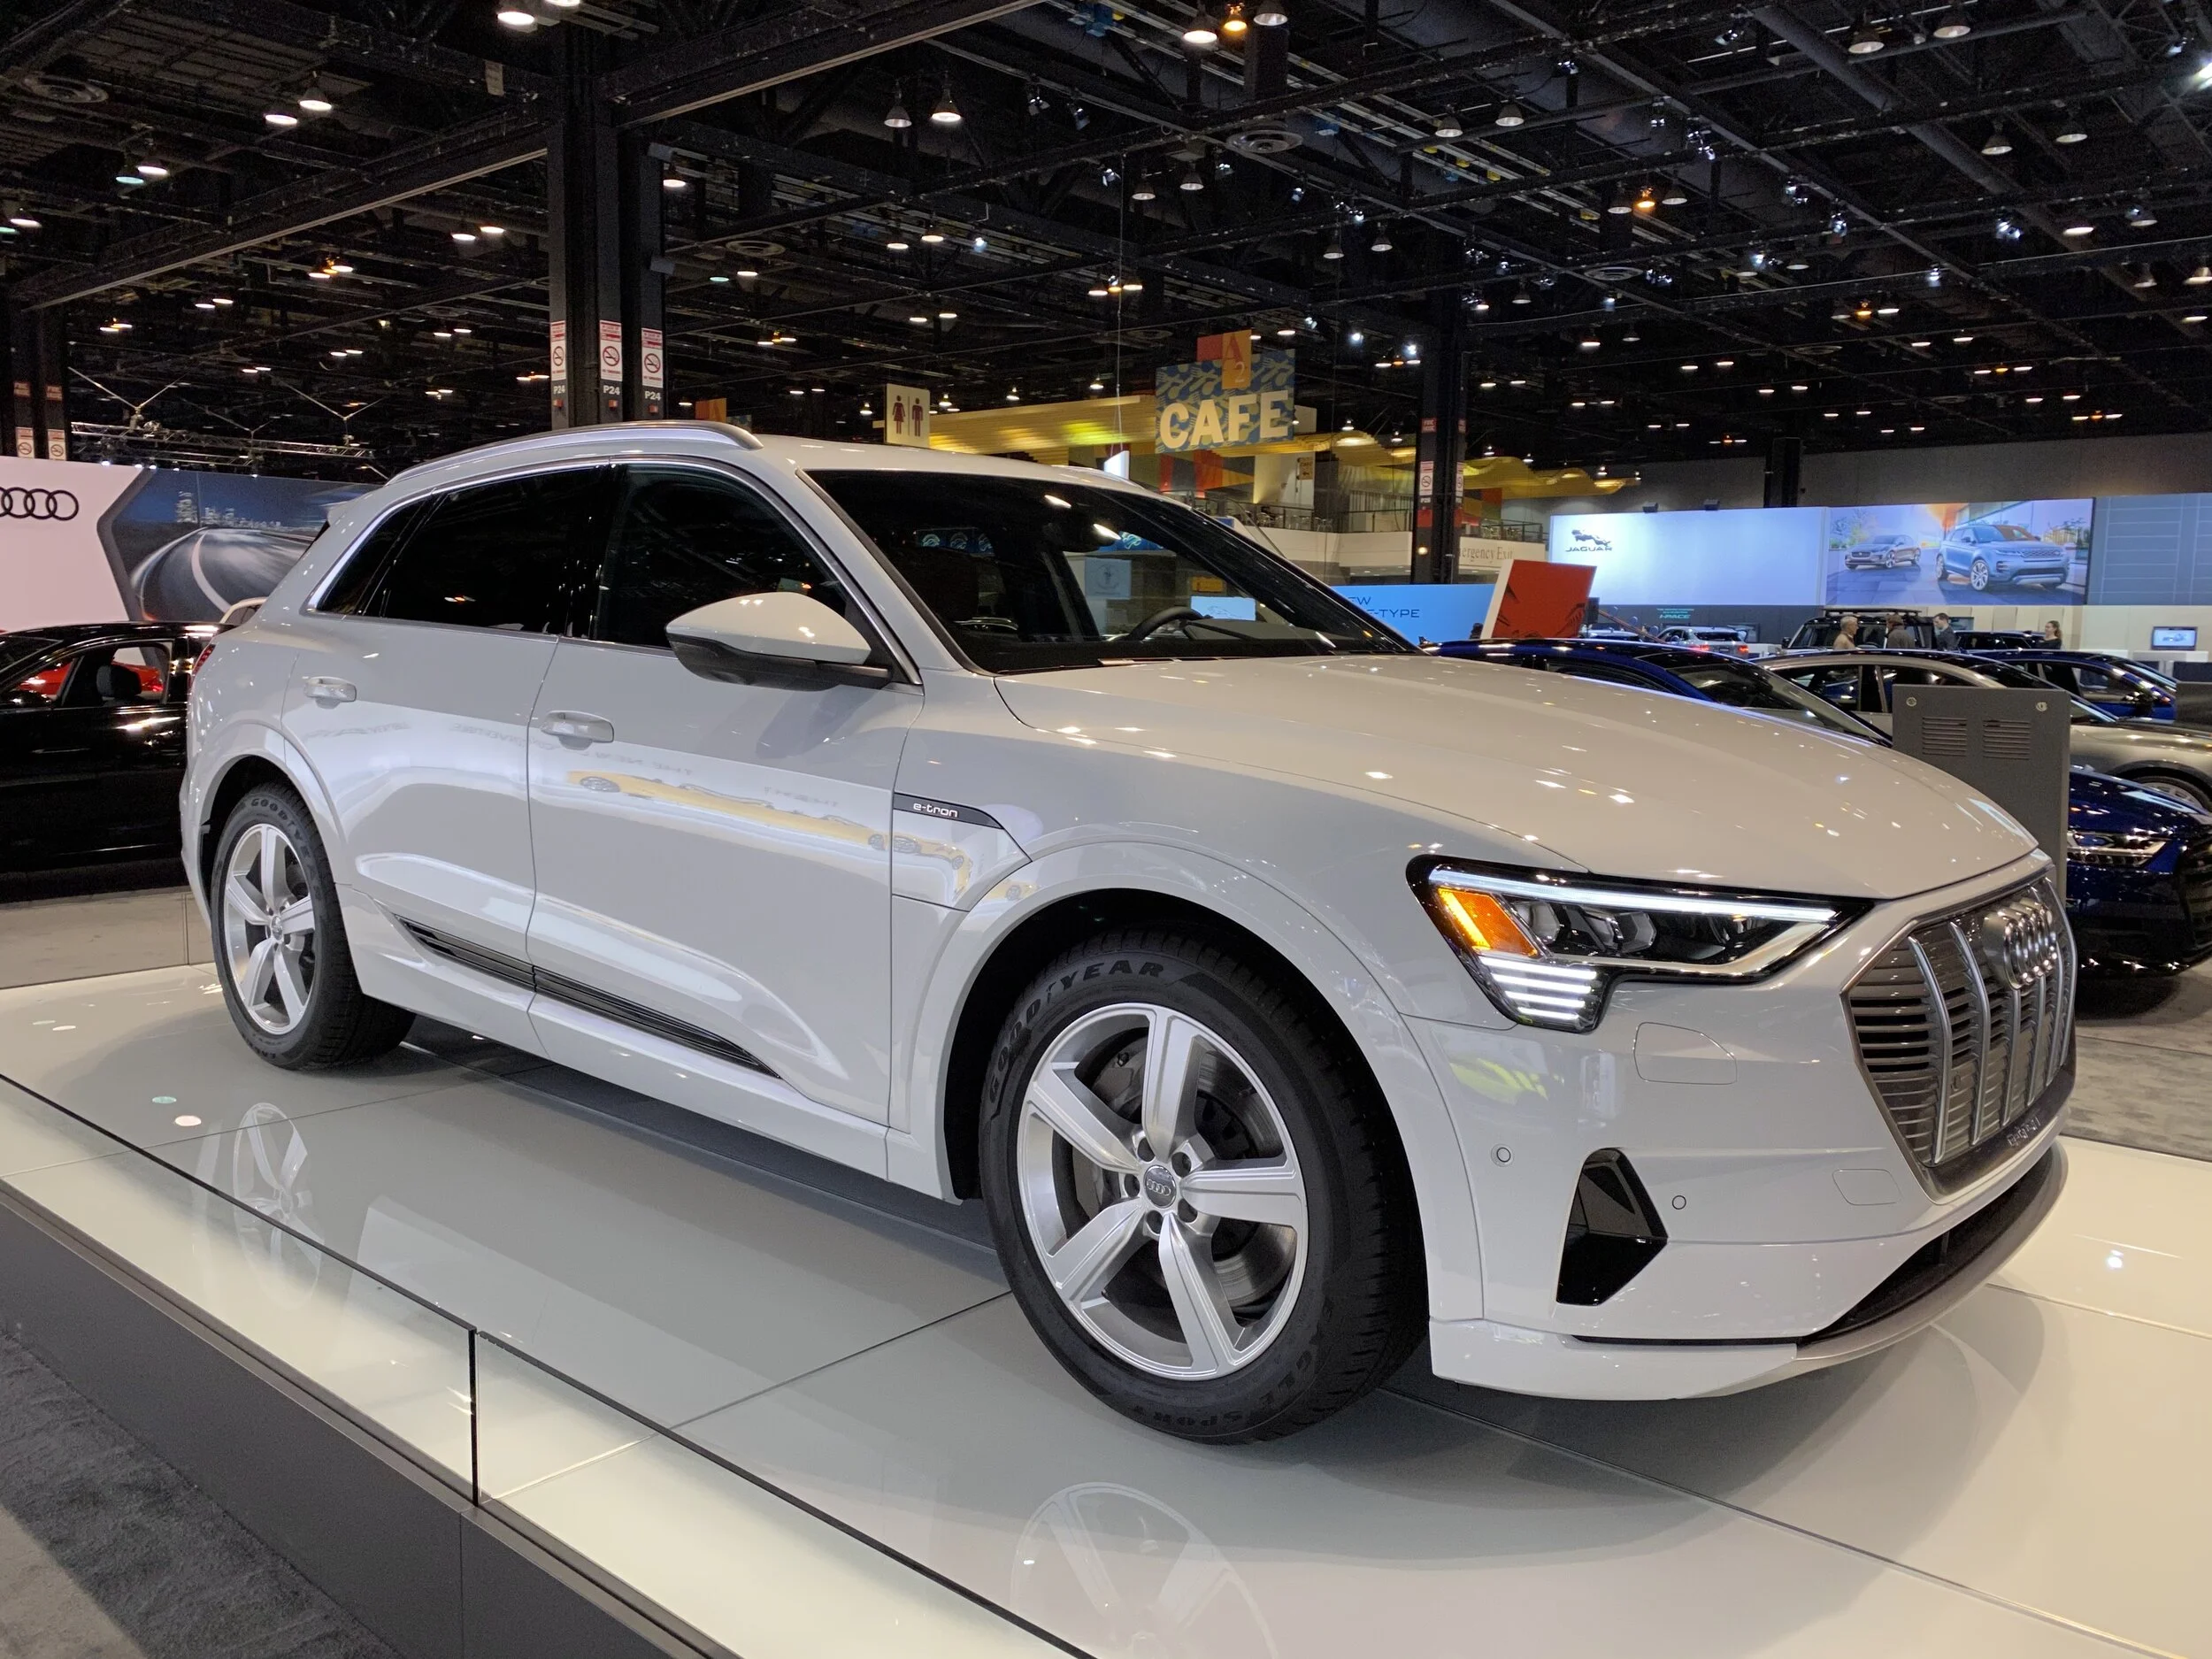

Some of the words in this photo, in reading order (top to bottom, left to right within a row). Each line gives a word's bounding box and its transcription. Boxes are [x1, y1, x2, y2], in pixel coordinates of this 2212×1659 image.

[1234, 361, 1246, 383] 2
[553, 385, 565, 395] P24
[603, 385, 620, 396] P24
[644, 390, 662, 401] P24
[1159, 389, 1289, 449] CAFE
[1460, 548, 1495, 564] ergency
[913, 803, 958, 818] e-tron
[989, 959, 1164, 1103] GOODYEAR
